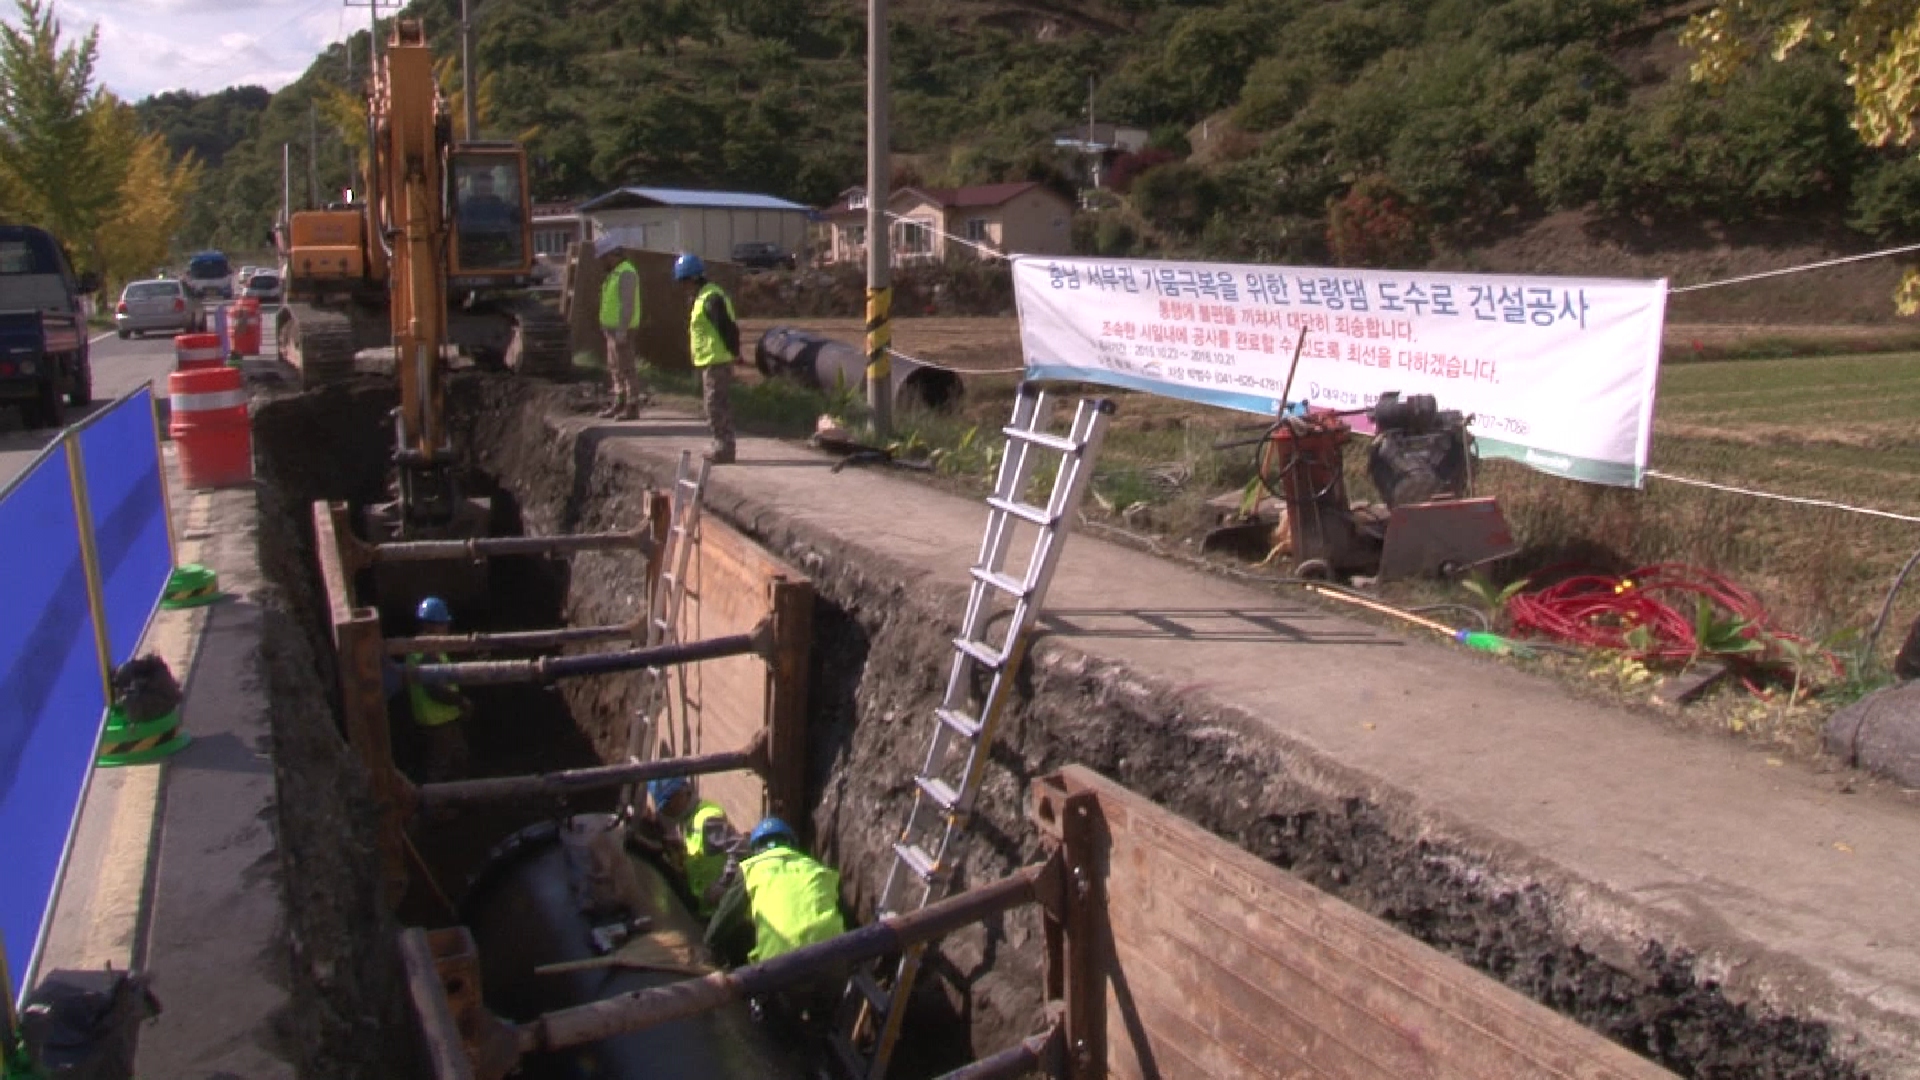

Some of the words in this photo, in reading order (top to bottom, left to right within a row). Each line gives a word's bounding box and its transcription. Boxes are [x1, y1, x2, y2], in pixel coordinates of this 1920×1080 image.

[1050, 261, 1081, 290] 충남
[1087, 264, 1139, 294] 서부권
[1142, 266, 1239, 302] 가뭄극복을
[1246, 272, 1291, 305] 위한
[1297, 275, 1369, 312] 보령댐
[1378, 280, 1459, 317] 도수로
[1468, 284, 1589, 330] 건설공사
[1158, 299, 1195, 322] 통행에
[1199, 303, 1237, 327] 불편을
[1242, 308, 1282, 330] 끼쳐서
[1286, 311, 1330, 335] 대단히
[1335, 314, 1417, 343] 죄송합니다.
[1101, 320, 1136, 341] 조속한
[1141, 324, 1189, 345] 시일내에
[1191, 327, 1231, 349] 공사를
[1235, 330, 1275, 355] 완료할
[1279, 335, 1295, 356] 수
[1301, 338, 1342, 362] 있도록
[1347, 341, 1392, 370] 최선을
[1398, 349, 1500, 385] 다하겠습니다.
